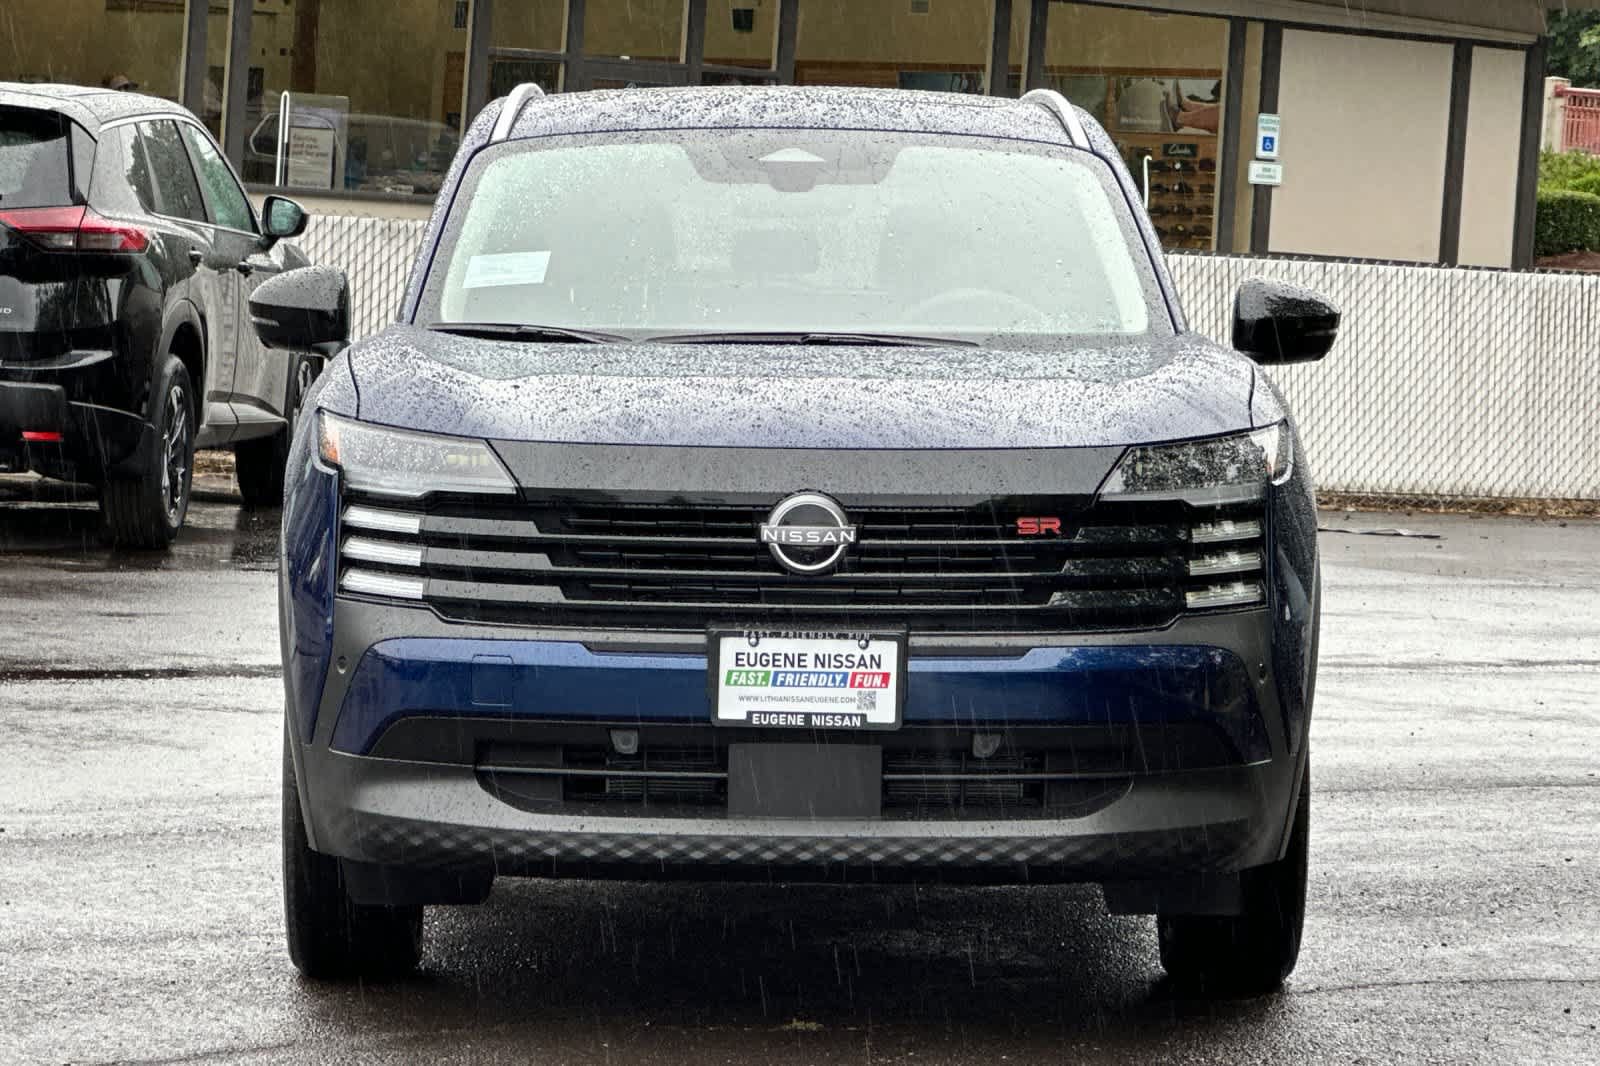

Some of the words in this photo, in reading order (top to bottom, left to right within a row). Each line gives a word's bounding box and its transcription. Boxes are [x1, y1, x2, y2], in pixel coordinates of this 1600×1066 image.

[1016, 517, 1062, 535] SR
[763, 528, 855, 543] NISSAN
[735, 652, 808, 668] EUGENE
[814, 653, 882, 669] NISSAN
[730, 671, 767, 686] FAST.
[776, 672, 845, 687] FRIENDLY.
[854, 673, 887, 688] FUN.
[738, 695, 857, 704] WWW.LITHIANISSANEUGENE.COM
[752, 713, 805, 726] EUGENE
[811, 714, 861, 727] NISSAN
